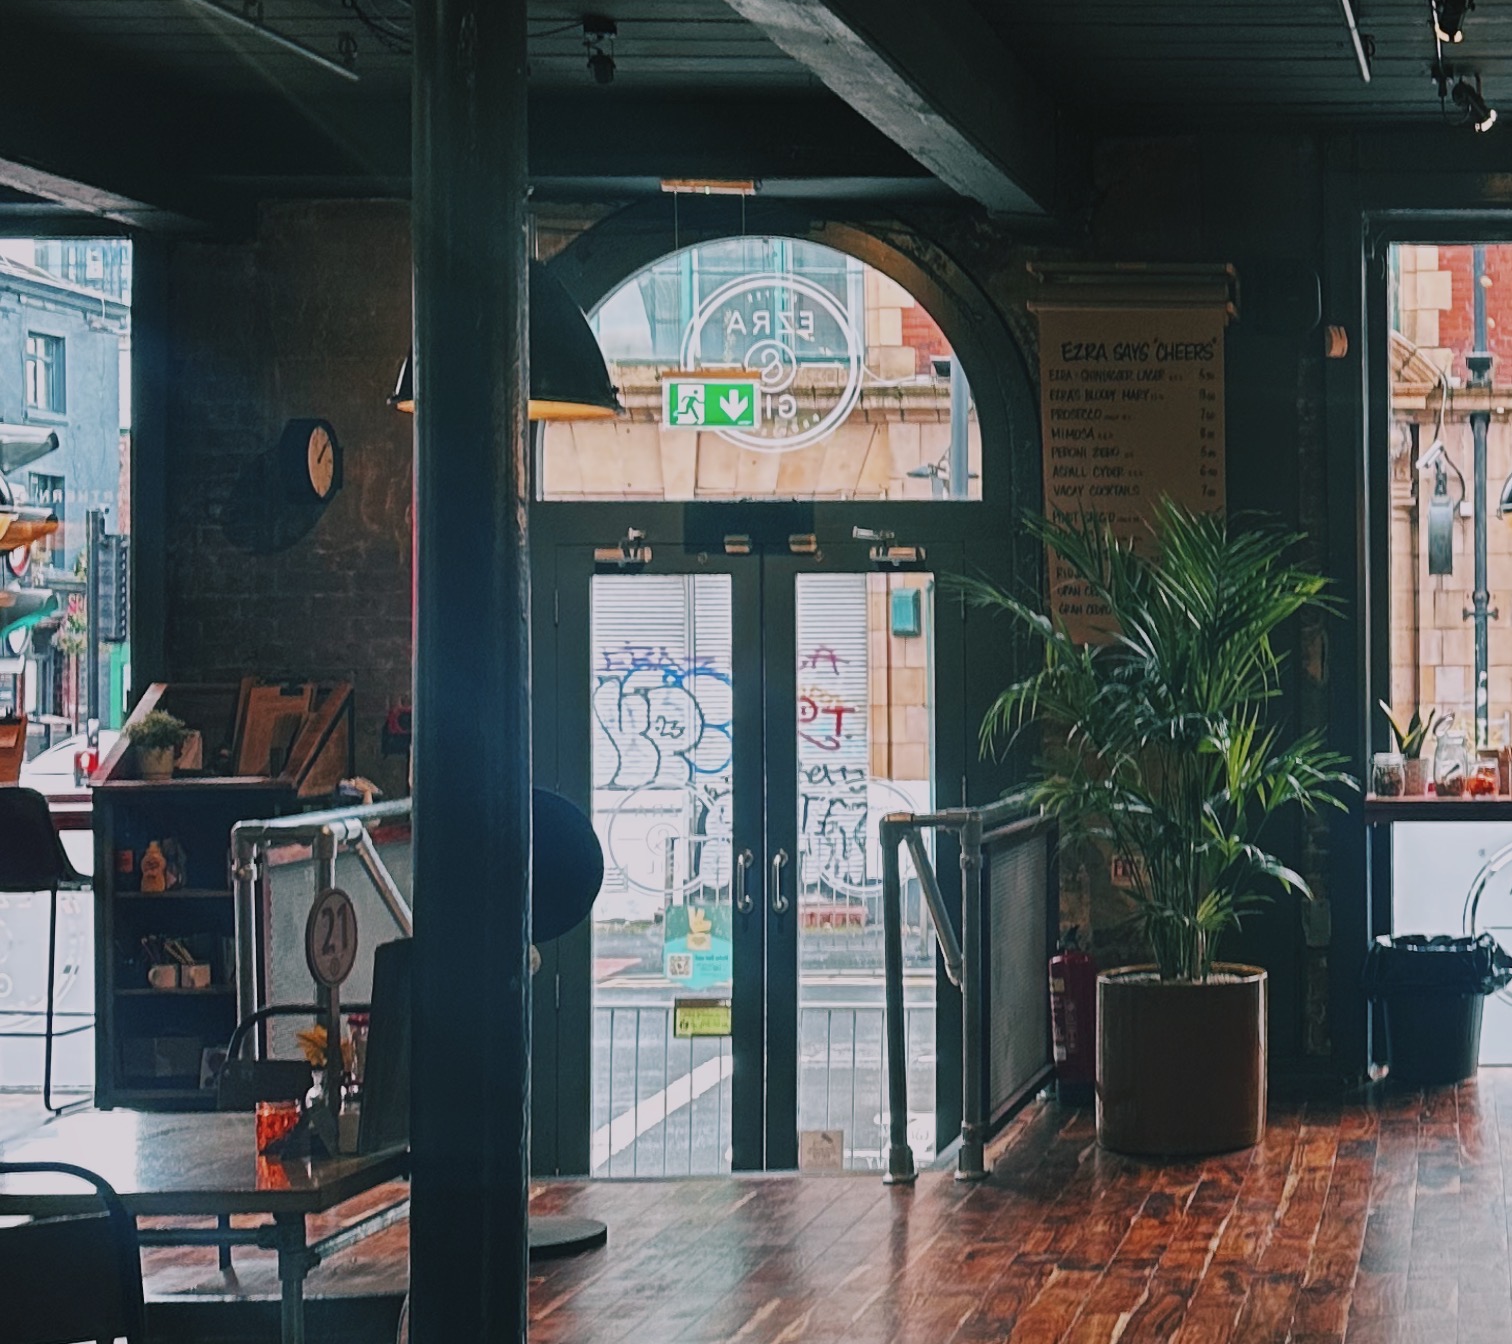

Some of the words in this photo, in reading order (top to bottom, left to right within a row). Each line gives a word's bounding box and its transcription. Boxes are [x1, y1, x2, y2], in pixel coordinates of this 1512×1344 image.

[1061, 341, 1107, 362] EZRA
[1113, 341, 1150, 362] SAYS
[1051, 409, 1103, 421] PROSECCO
[1051, 427, 1095, 440] MIMOSA
[321, 902, 347, 956] 21
